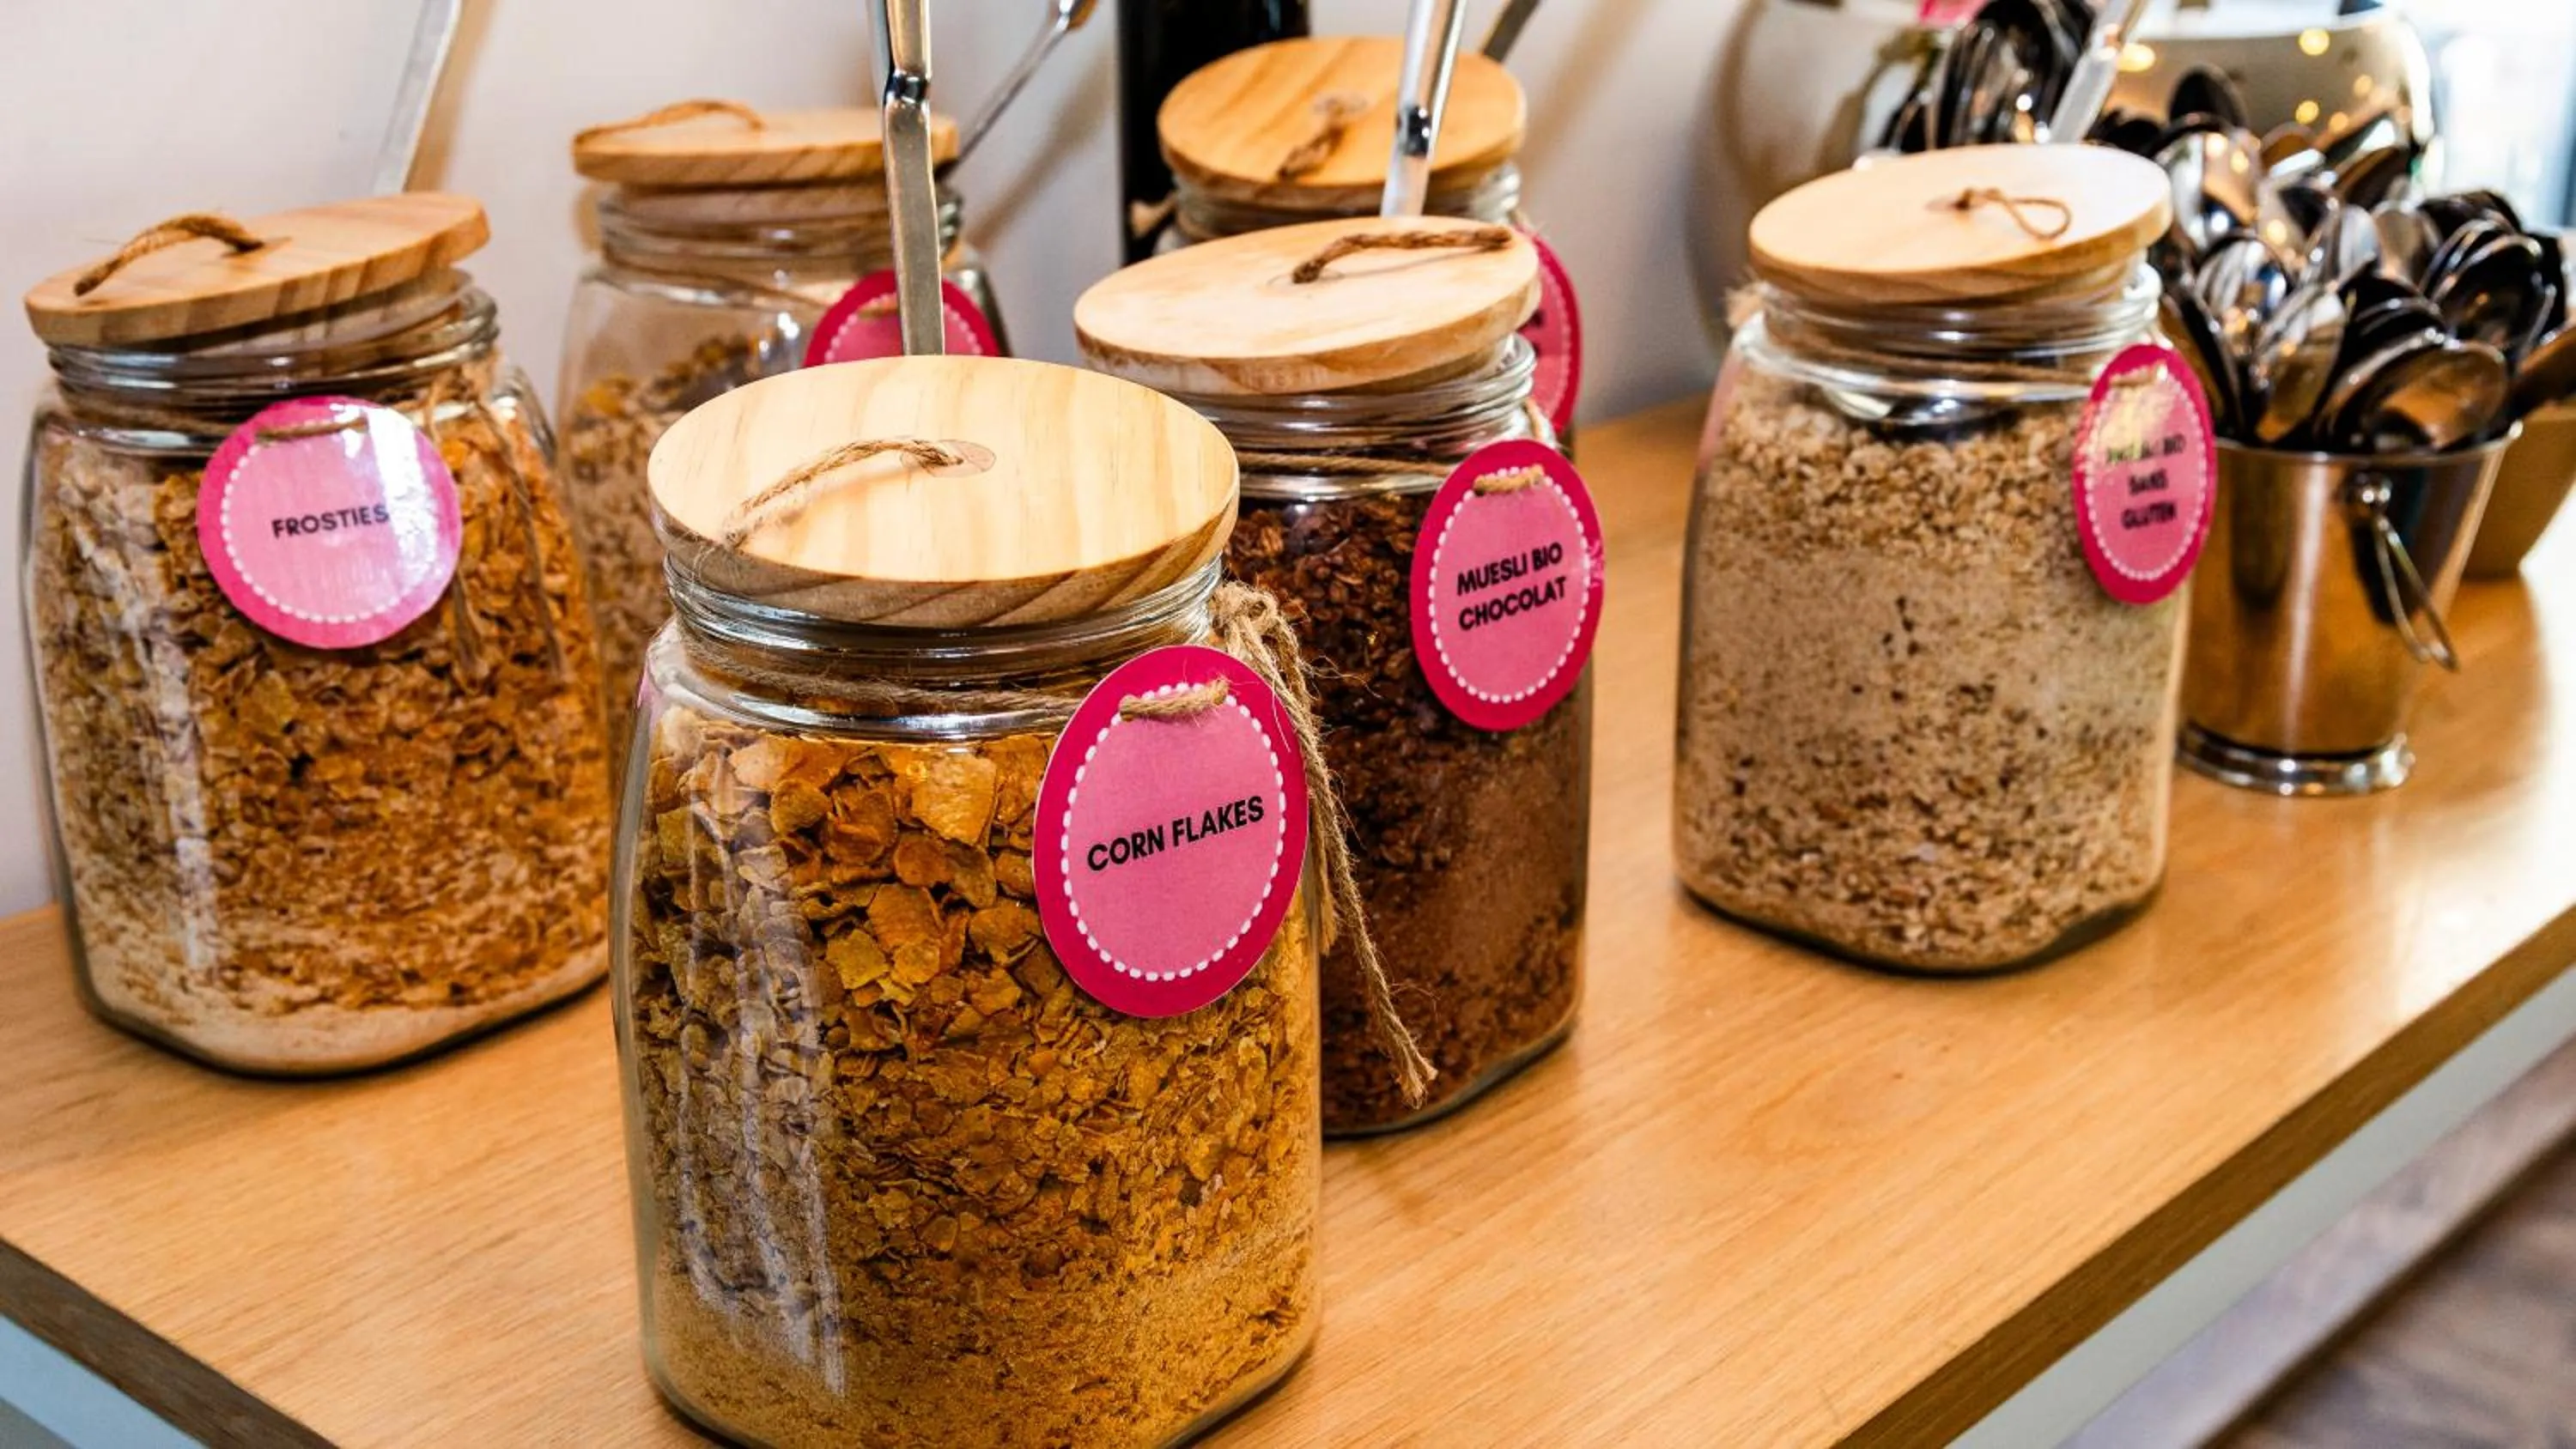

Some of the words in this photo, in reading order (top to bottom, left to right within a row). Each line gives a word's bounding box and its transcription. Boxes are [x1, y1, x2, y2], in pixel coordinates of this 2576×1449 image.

[271, 503, 390, 539] FROSTIES
[1457, 553, 1528, 596] MUESLI
[1531, 542, 1564, 572] BIO
[1459, 576, 1566, 631] CHOCOLAT
[1086, 825, 1164, 871] CORN
[1170, 796, 1265, 847] FLAKES
